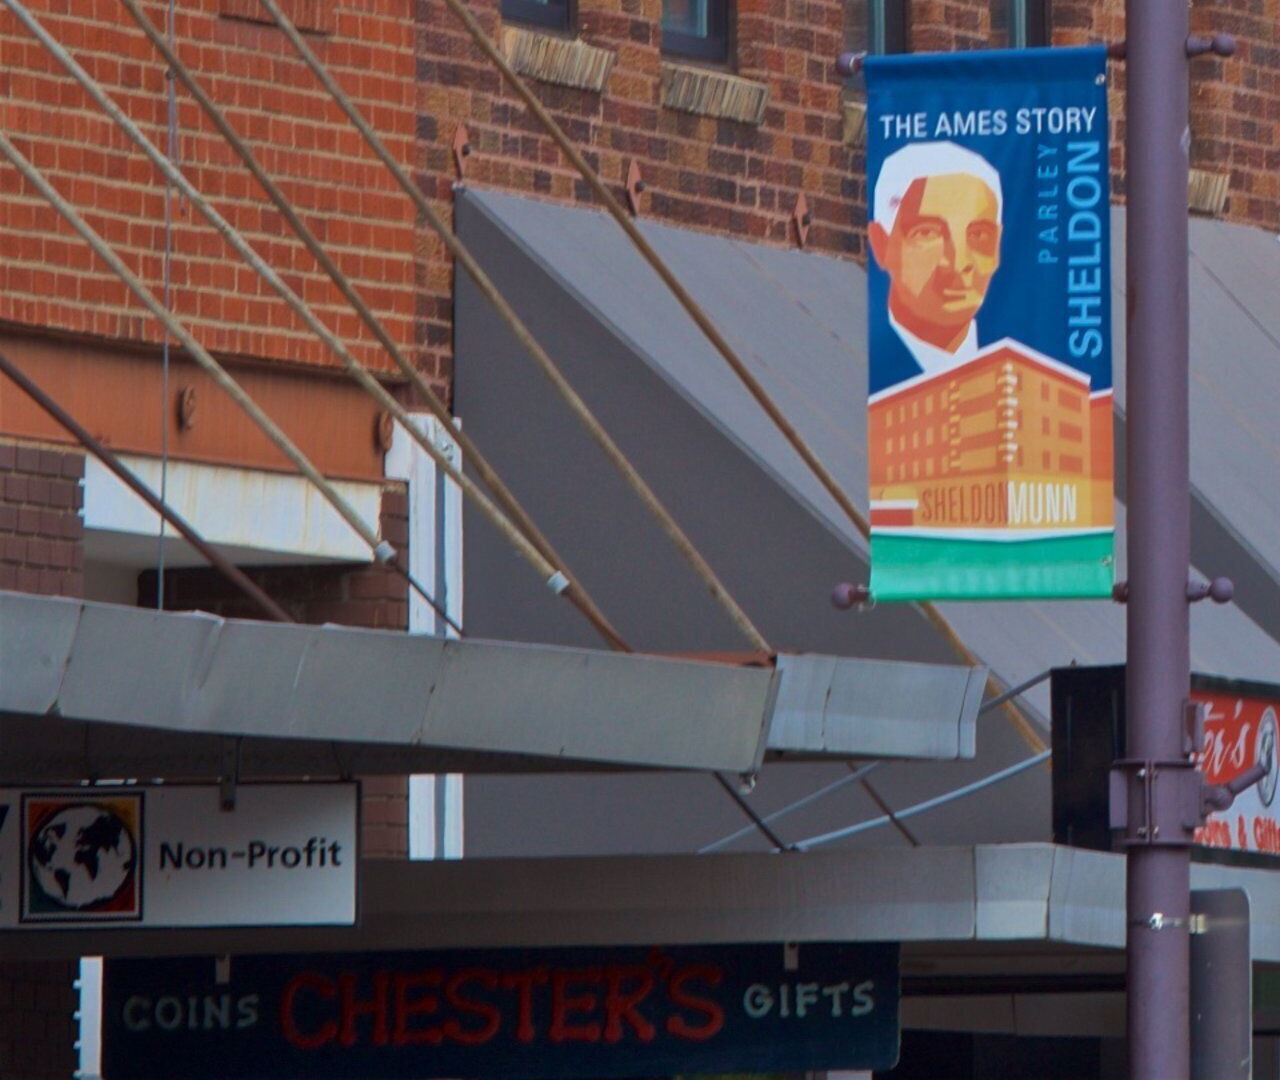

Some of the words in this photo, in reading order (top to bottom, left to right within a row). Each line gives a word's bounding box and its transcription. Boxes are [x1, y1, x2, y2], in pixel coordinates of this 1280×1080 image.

[880, 111, 927, 139] THE
[935, 108, 1007, 138] AMES
[1015, 106, 1096, 135] STORY
[1037, 143, 1059, 264] PARLEY
[1066, 140, 1103, 358] SHELDON
[1007, 480, 1078, 525] MUNN
[160, 836, 342, 870] Non-Profit
[122, 993, 261, 1033] COINS
[278, 945, 726, 1051] CHESTER'S
[742, 981, 876, 1020] GIFTS
